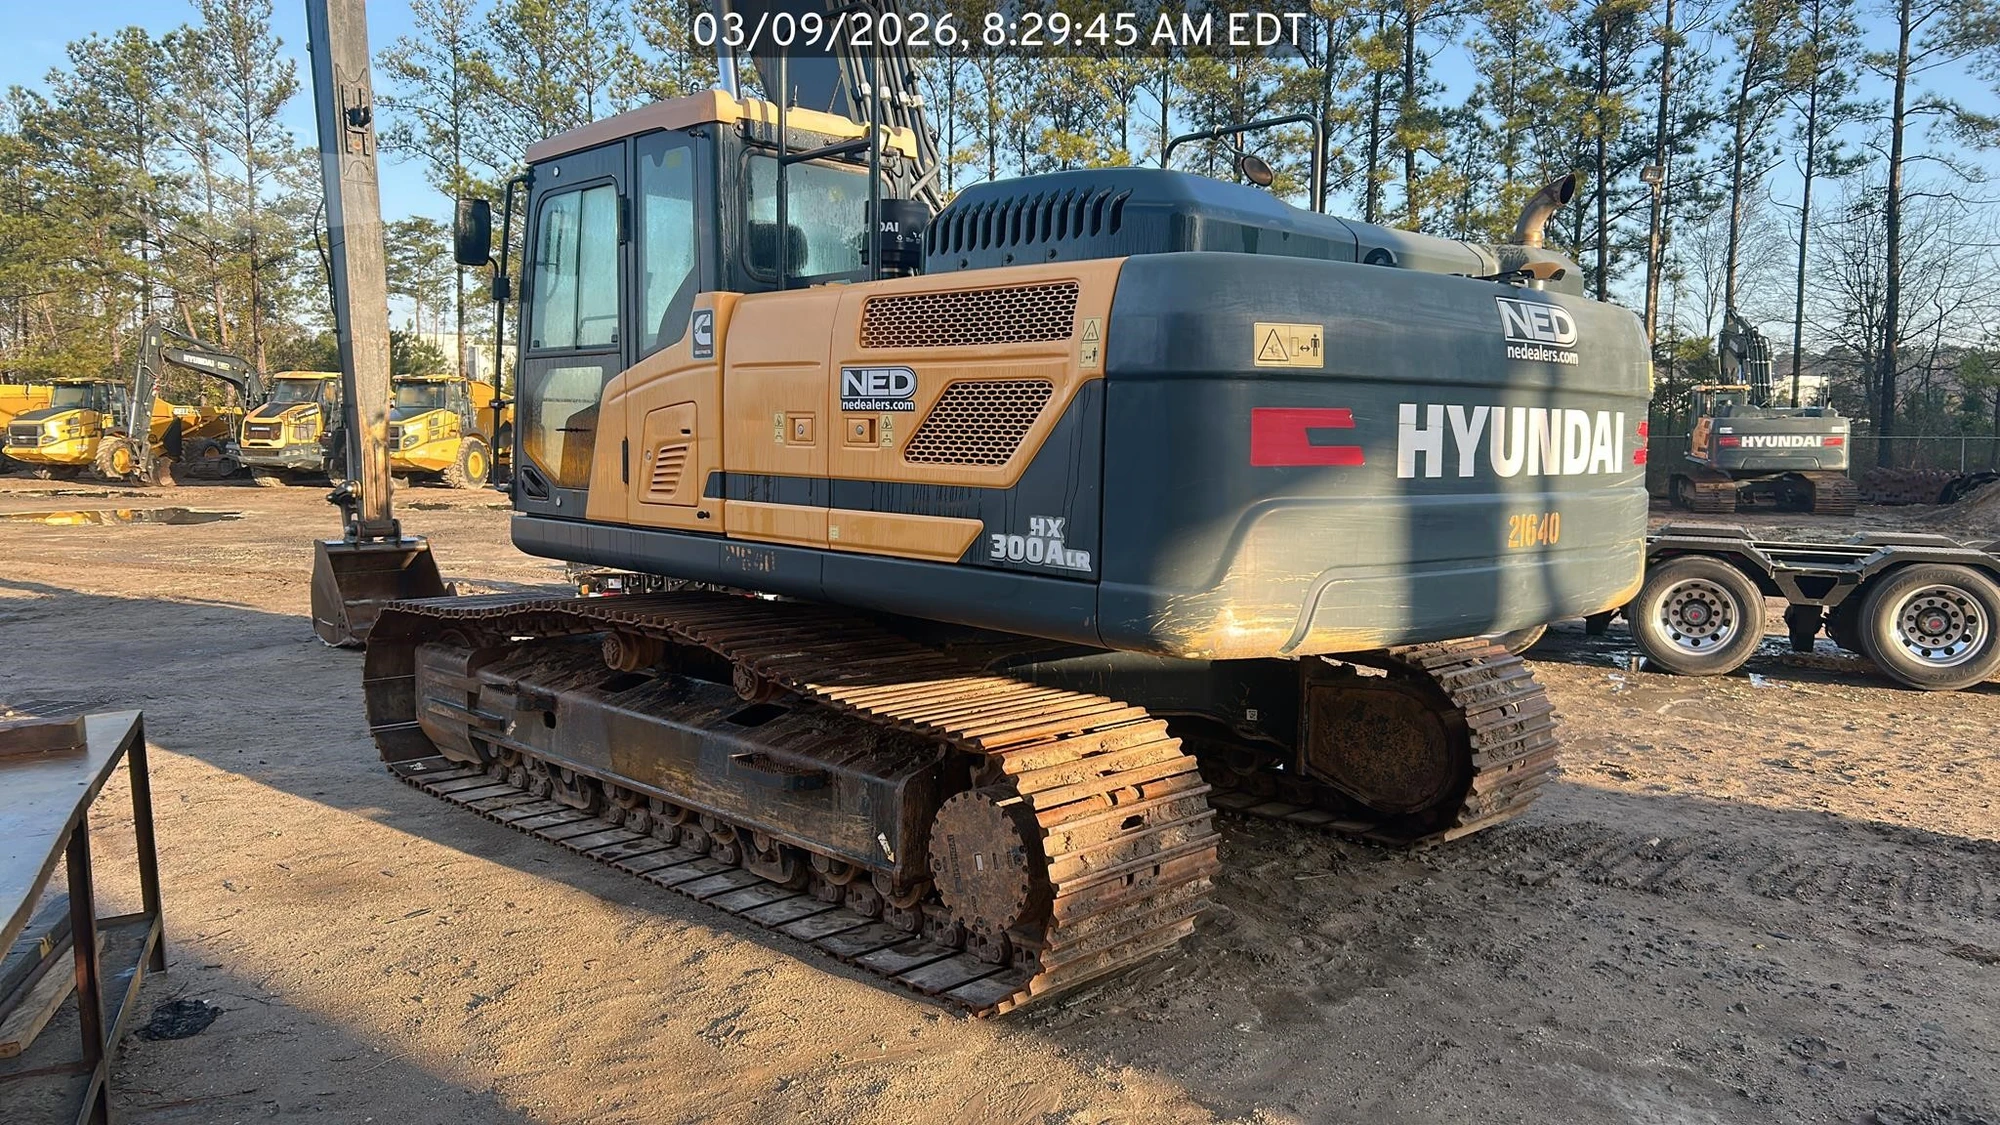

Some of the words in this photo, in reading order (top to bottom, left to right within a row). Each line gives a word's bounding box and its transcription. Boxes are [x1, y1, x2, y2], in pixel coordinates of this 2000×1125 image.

[1498, 300, 1577, 344] NED
[1507, 343, 1579, 366] nedealers.com
[842, 368, 916, 398] NED
[842, 399, 914, 410] nedealers.com
[1397, 403, 1624, 479] HYUNDAI
[1741, 435, 1823, 448] HYUNDAI
[1030, 516, 1064, 538] HX
[1507, 512, 1561, 548] 21640
